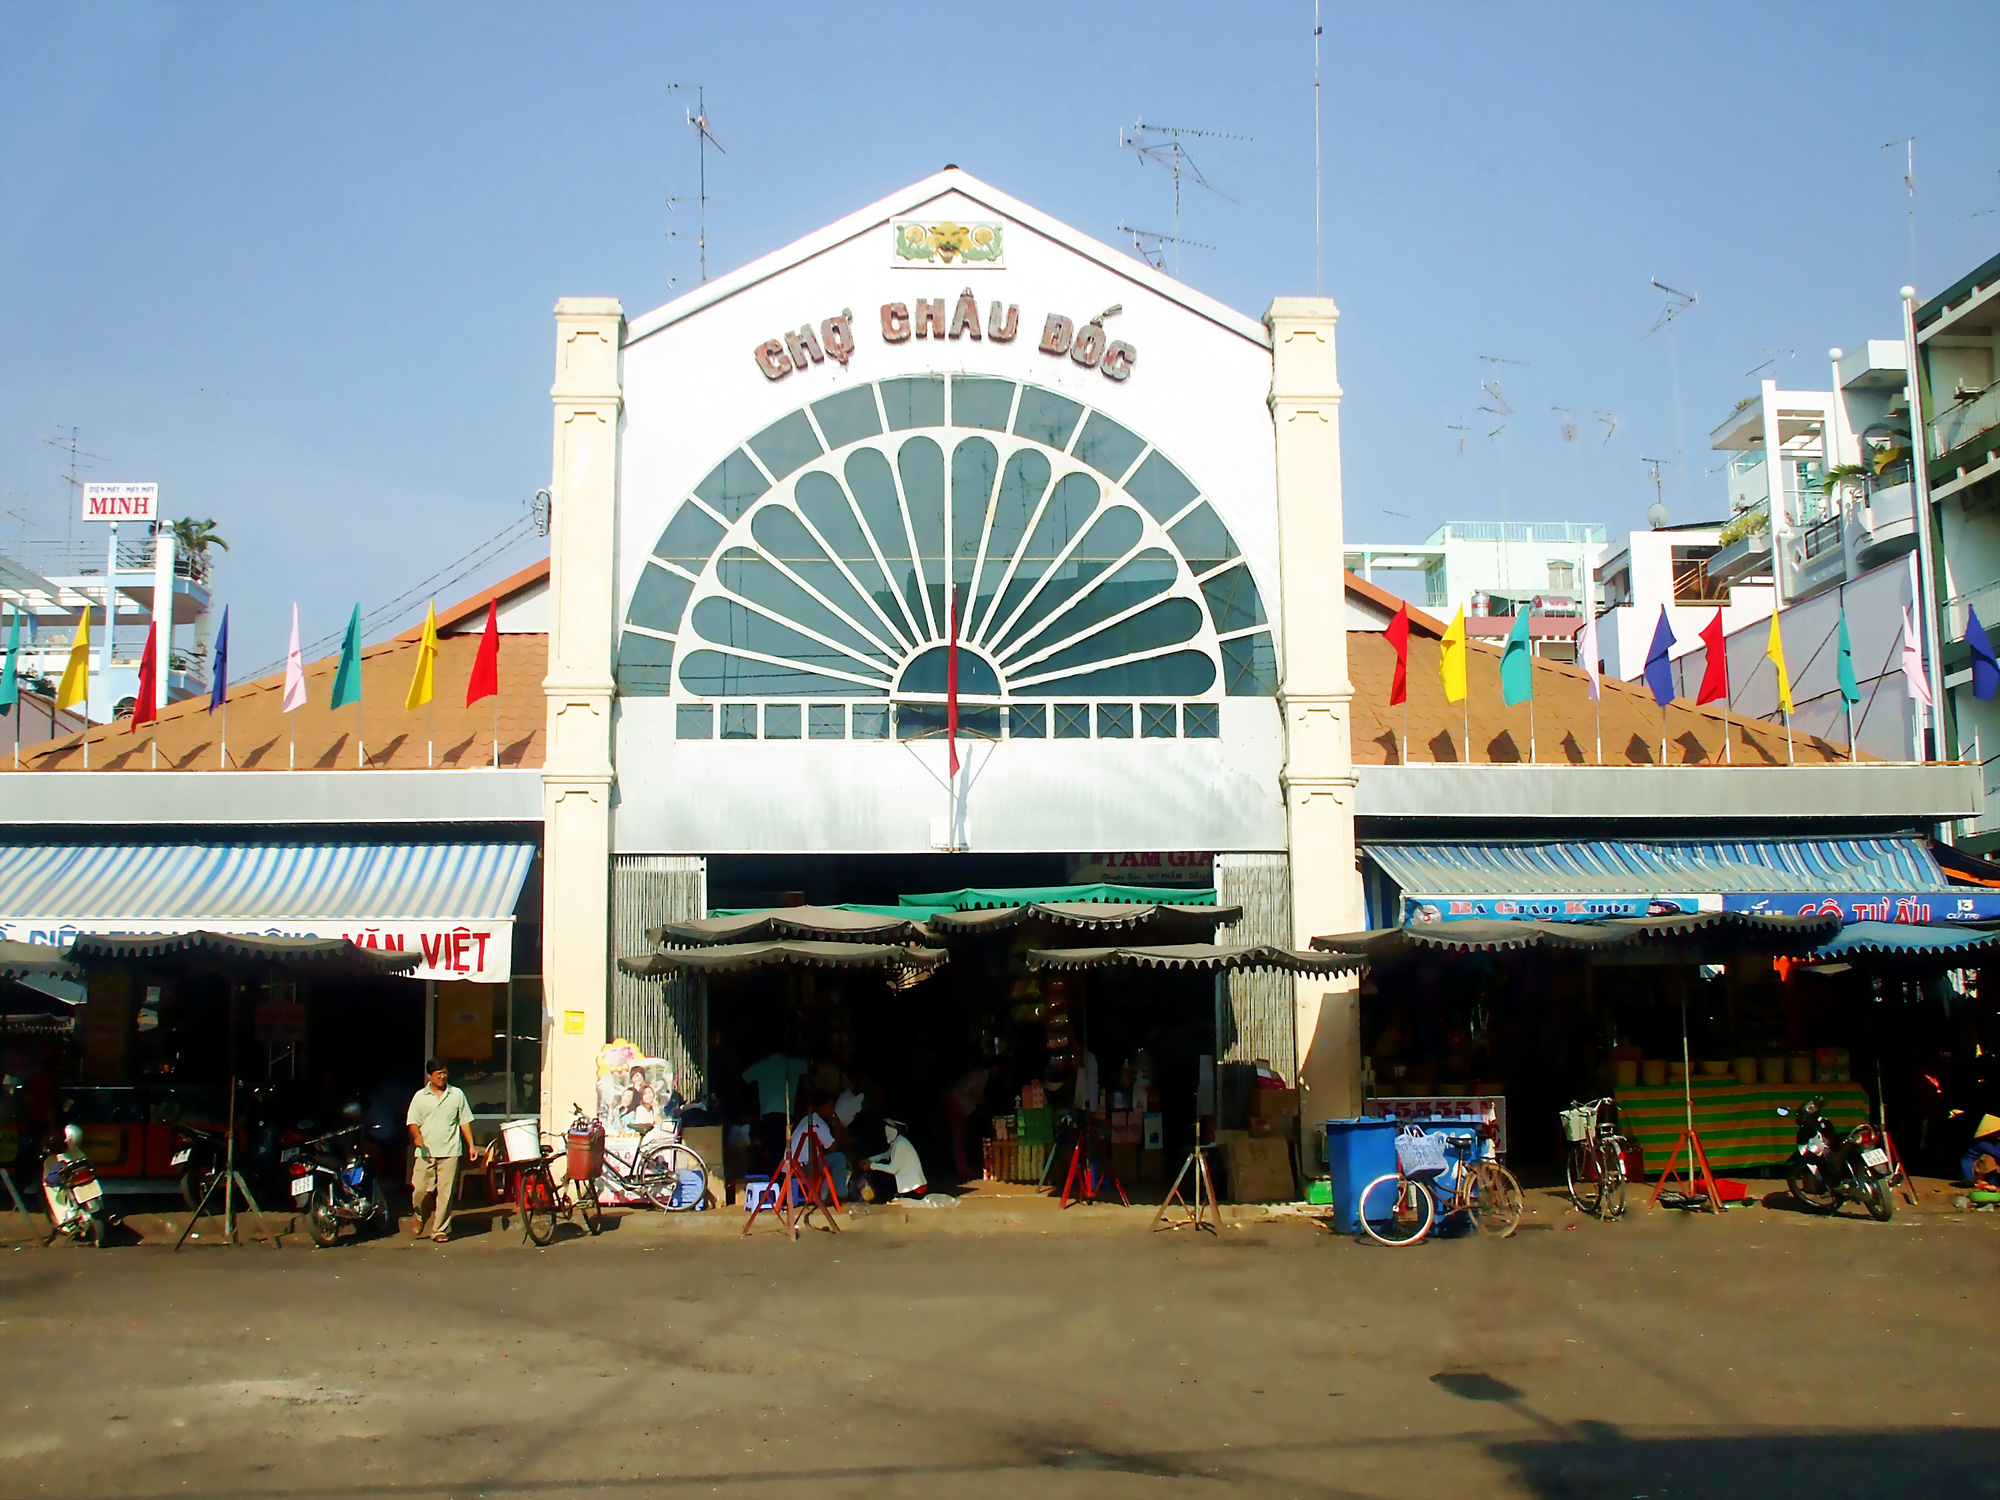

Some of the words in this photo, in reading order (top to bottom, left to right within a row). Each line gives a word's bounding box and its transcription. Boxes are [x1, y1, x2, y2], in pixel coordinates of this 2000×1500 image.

[754, 307, 854, 380] CHỢ
[880, 286, 1019, 345] CHÂU
[1038, 303, 1137, 382] ĐỐC
[89, 497, 149, 514] MINH
[1448, 901, 1488, 915] BÀ
[1957, 899, 1974, 911] 13
[420, 926, 491, 976] VIỆT
